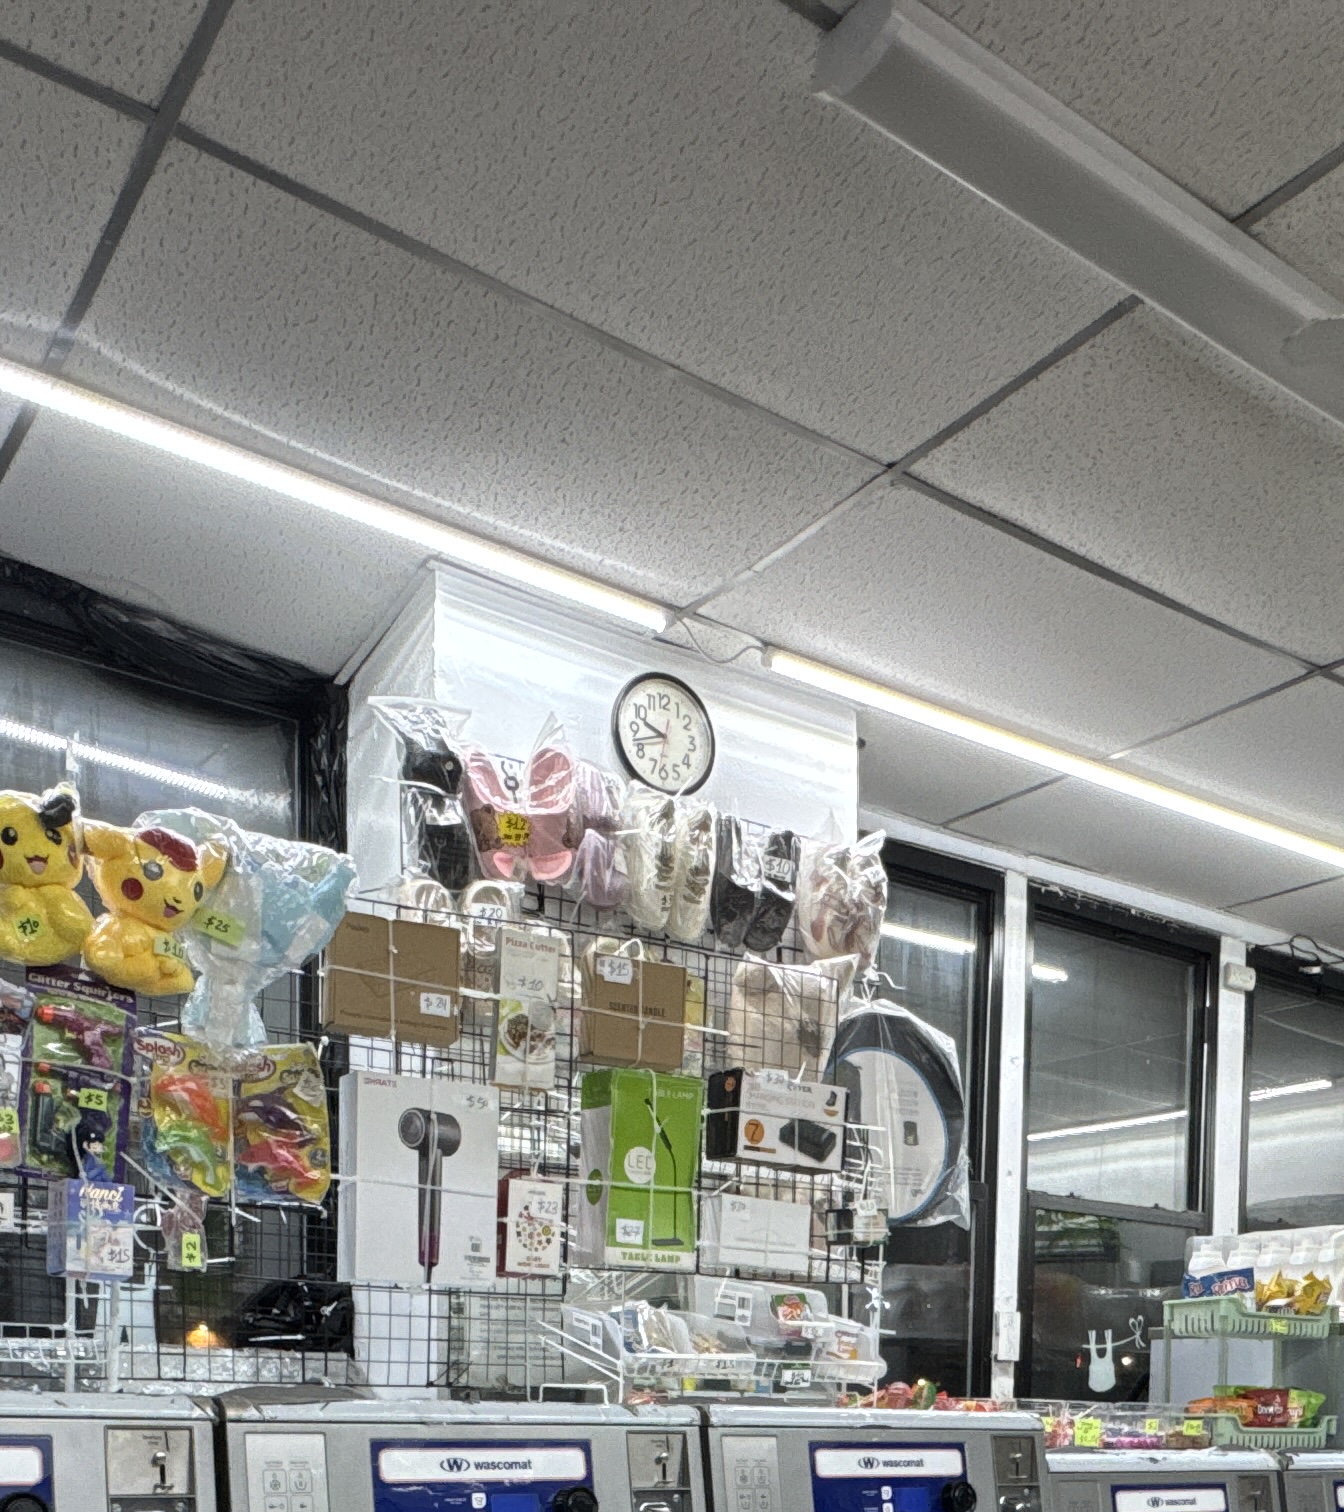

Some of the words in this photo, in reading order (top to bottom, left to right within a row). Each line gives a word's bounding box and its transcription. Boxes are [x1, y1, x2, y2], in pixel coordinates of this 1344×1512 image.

[646, 693, 656, 711] 11
[657, 691, 671, 711] 12
[633, 702, 647, 720] 10
[675, 701, 680, 719] 1
[629, 720, 640, 737] 9
[682, 713, 692, 731] 2
[636, 742, 645, 759] 8
[688, 735, 697, 752] 3
[648, 757, 658, 775] 7
[682, 753, 692, 770] 4
[658, 763, 669, 781] 6
[672, 764, 681, 781] 5
[478, 906, 504, 919] $20
[17, 916, 40, 937] $10
[203, 915, 231, 933] $25
[505, 936, 528, 949] Pizza
[607, 961, 631, 977] $15
[28, 971, 72, 989] Glitter
[517, 975, 545, 991] $10
[136, 1038, 182, 1059] Splash
[84, 1092, 104, 1106] $5
[79, 1182, 124, 1201] Nanci
[537, 1199, 559, 1215] $23
[107, 1248, 131, 1265] $15
[184, 1240, 199, 1263] $2
[654, 1252, 682, 1264] LAMP
[473, 1457, 533, 1472] wascomat
[881, 1457, 924, 1469] wascomat
